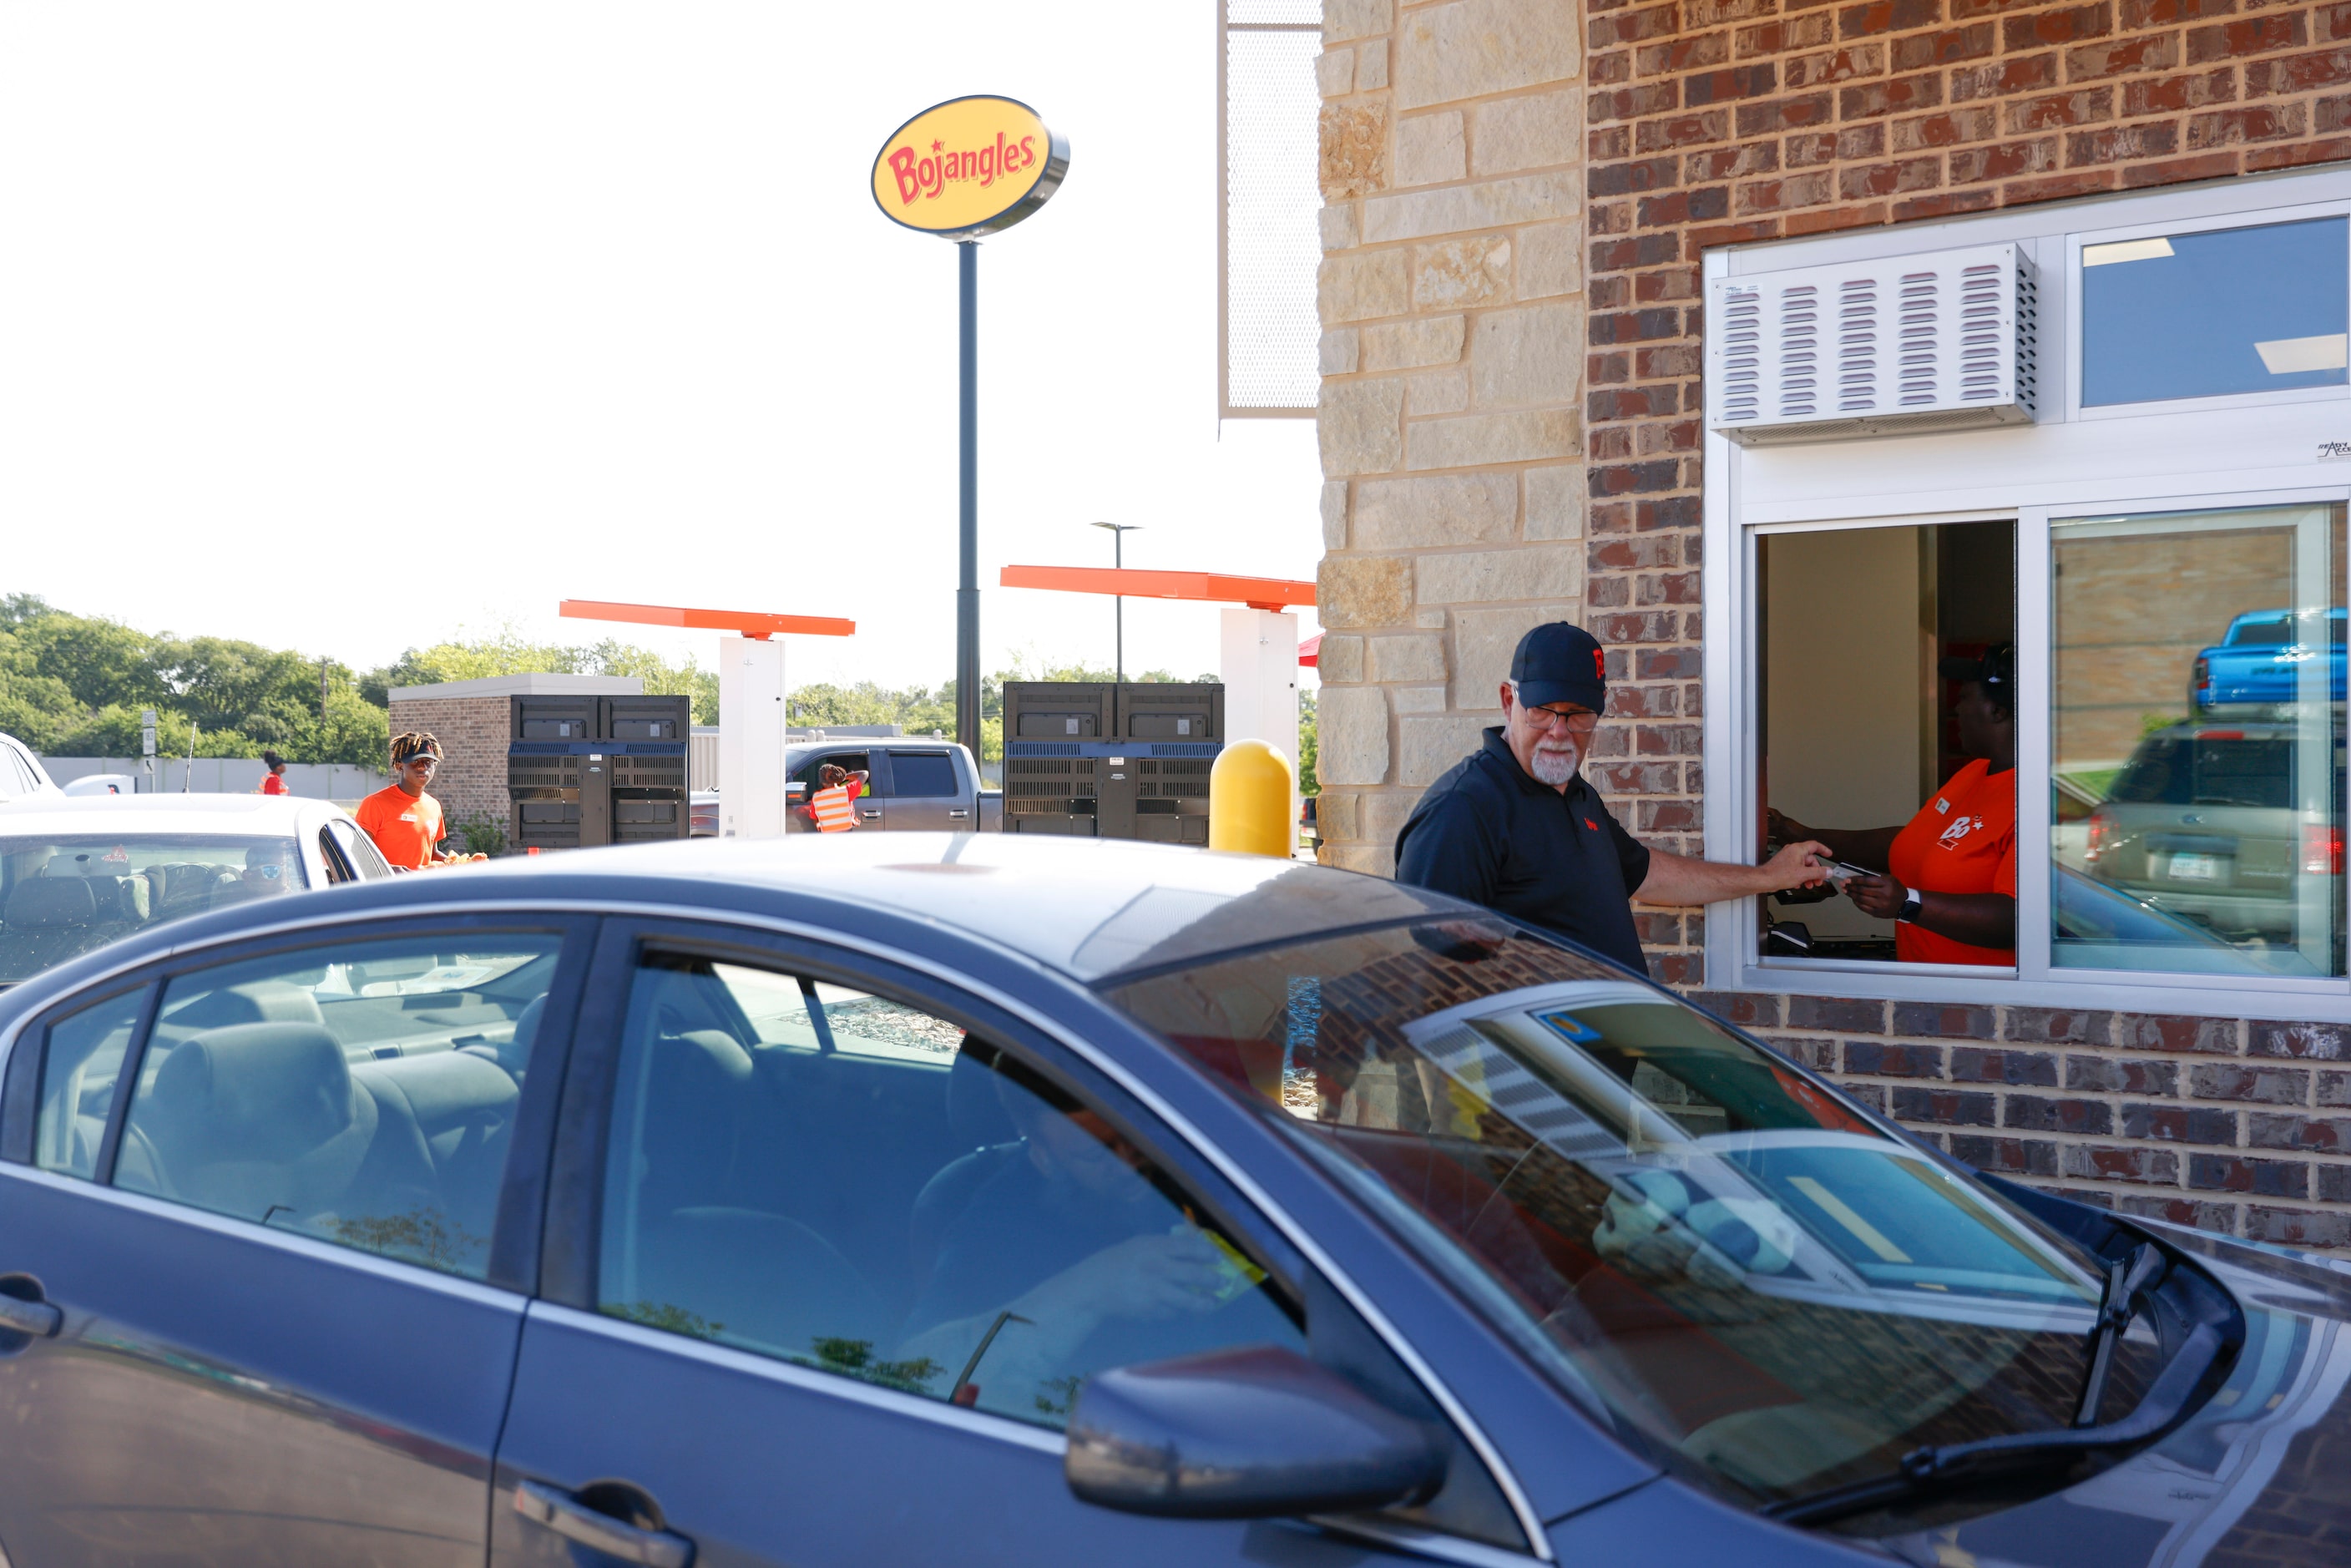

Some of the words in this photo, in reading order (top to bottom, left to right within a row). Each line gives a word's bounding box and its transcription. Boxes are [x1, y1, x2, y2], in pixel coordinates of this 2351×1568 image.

[887, 131, 1034, 205] Bojangles
[2318, 441, 2348, 456] READY
[1939, 817, 1970, 839] Bo
